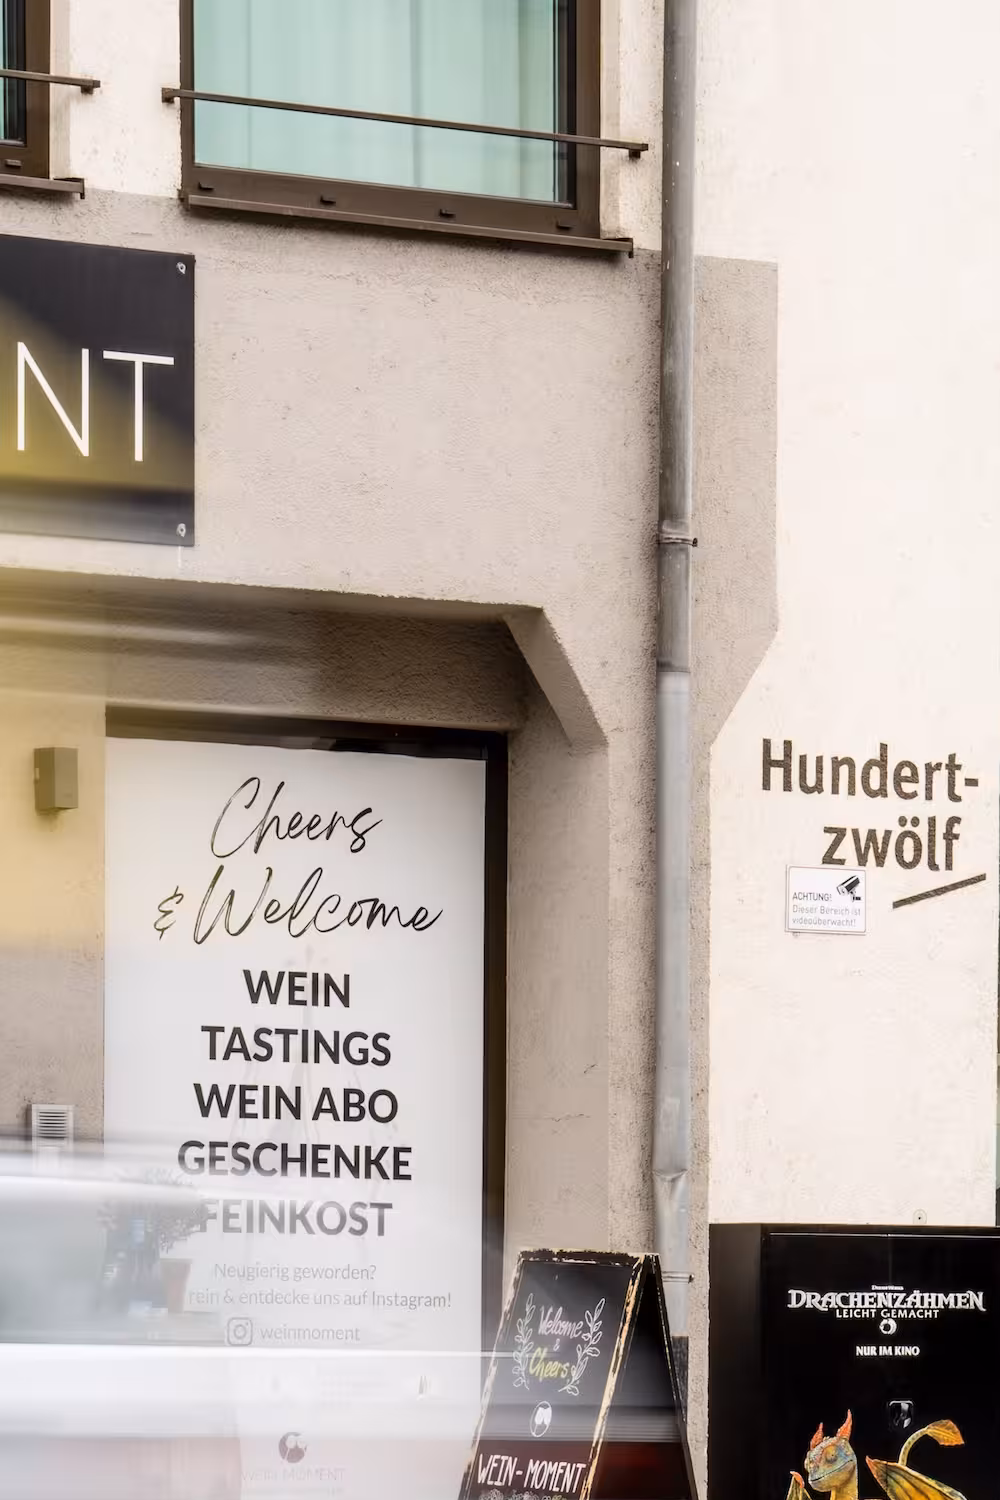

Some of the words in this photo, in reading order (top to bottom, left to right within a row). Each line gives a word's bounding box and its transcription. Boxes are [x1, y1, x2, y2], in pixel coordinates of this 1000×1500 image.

[17, 341, 175, 462] NT
[761, 737, 979, 803] Hundert-
[209, 776, 383, 859] Cheers
[821, 815, 962, 872] zwölf
[153, 885, 184, 940] &
[193, 864, 443, 945] Welcome
[792, 891, 832, 902] ACHTUNG!
[792, 904, 818, 914] Dieser
[820, 905, 849, 916] Bereich
[243, 969, 350, 1008] WEIN
[201, 1025, 392, 1067] TASTINGS
[193, 1083, 301, 1120] WEIN
[312, 1087, 399, 1123] ABO
[177, 1139, 413, 1181] GESCHENKE
[198, 1198, 394, 1237] FEINKOST
[214, 1261, 290, 1282] Neugierig
[293, 1264, 377, 1282] geworden?
[240, 1288, 310, 1306] entdecke
[314, 1293, 340, 1306] uns
[345, 1289, 368, 1306] auf
[372, 1290, 452, 1311] Instagram!
[787, 1289, 987, 1312] DRACHENZÄHMEN
[836, 1309, 877, 1319] LEICHT
[880, 1308, 940, 1319] GEMACHT
[260, 1325, 361, 1342] weinmoment
[538, 1305, 584, 1339] Welcome
[528, 1346, 570, 1382] Cheers
[856, 1345, 877, 1356] NUR
[879, 1345, 893, 1356] IM
[894, 1345, 921, 1356] KINO
